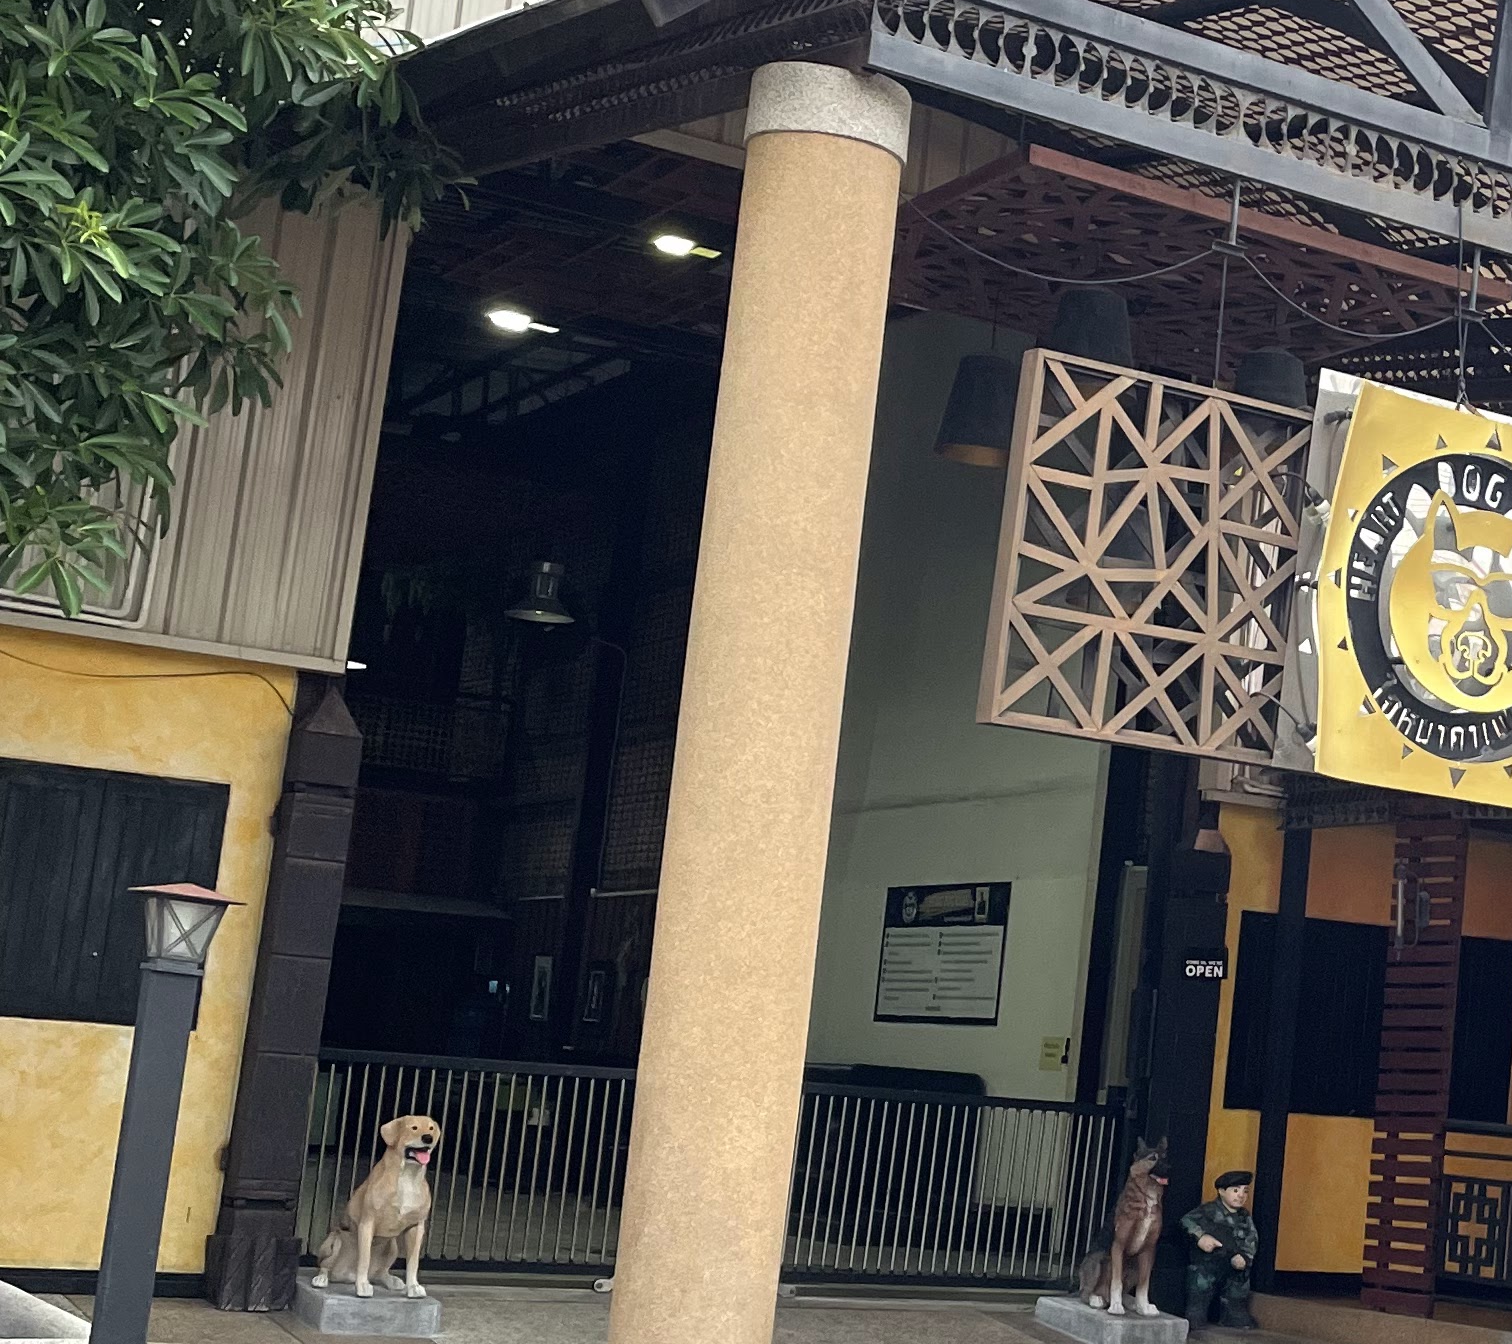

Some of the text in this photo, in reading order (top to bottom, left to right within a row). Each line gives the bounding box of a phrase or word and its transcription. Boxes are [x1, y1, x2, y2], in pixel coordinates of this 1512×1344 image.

[1349, 461, 1507, 602] HEART DOG
[1185, 965, 1223, 977] OPEN
